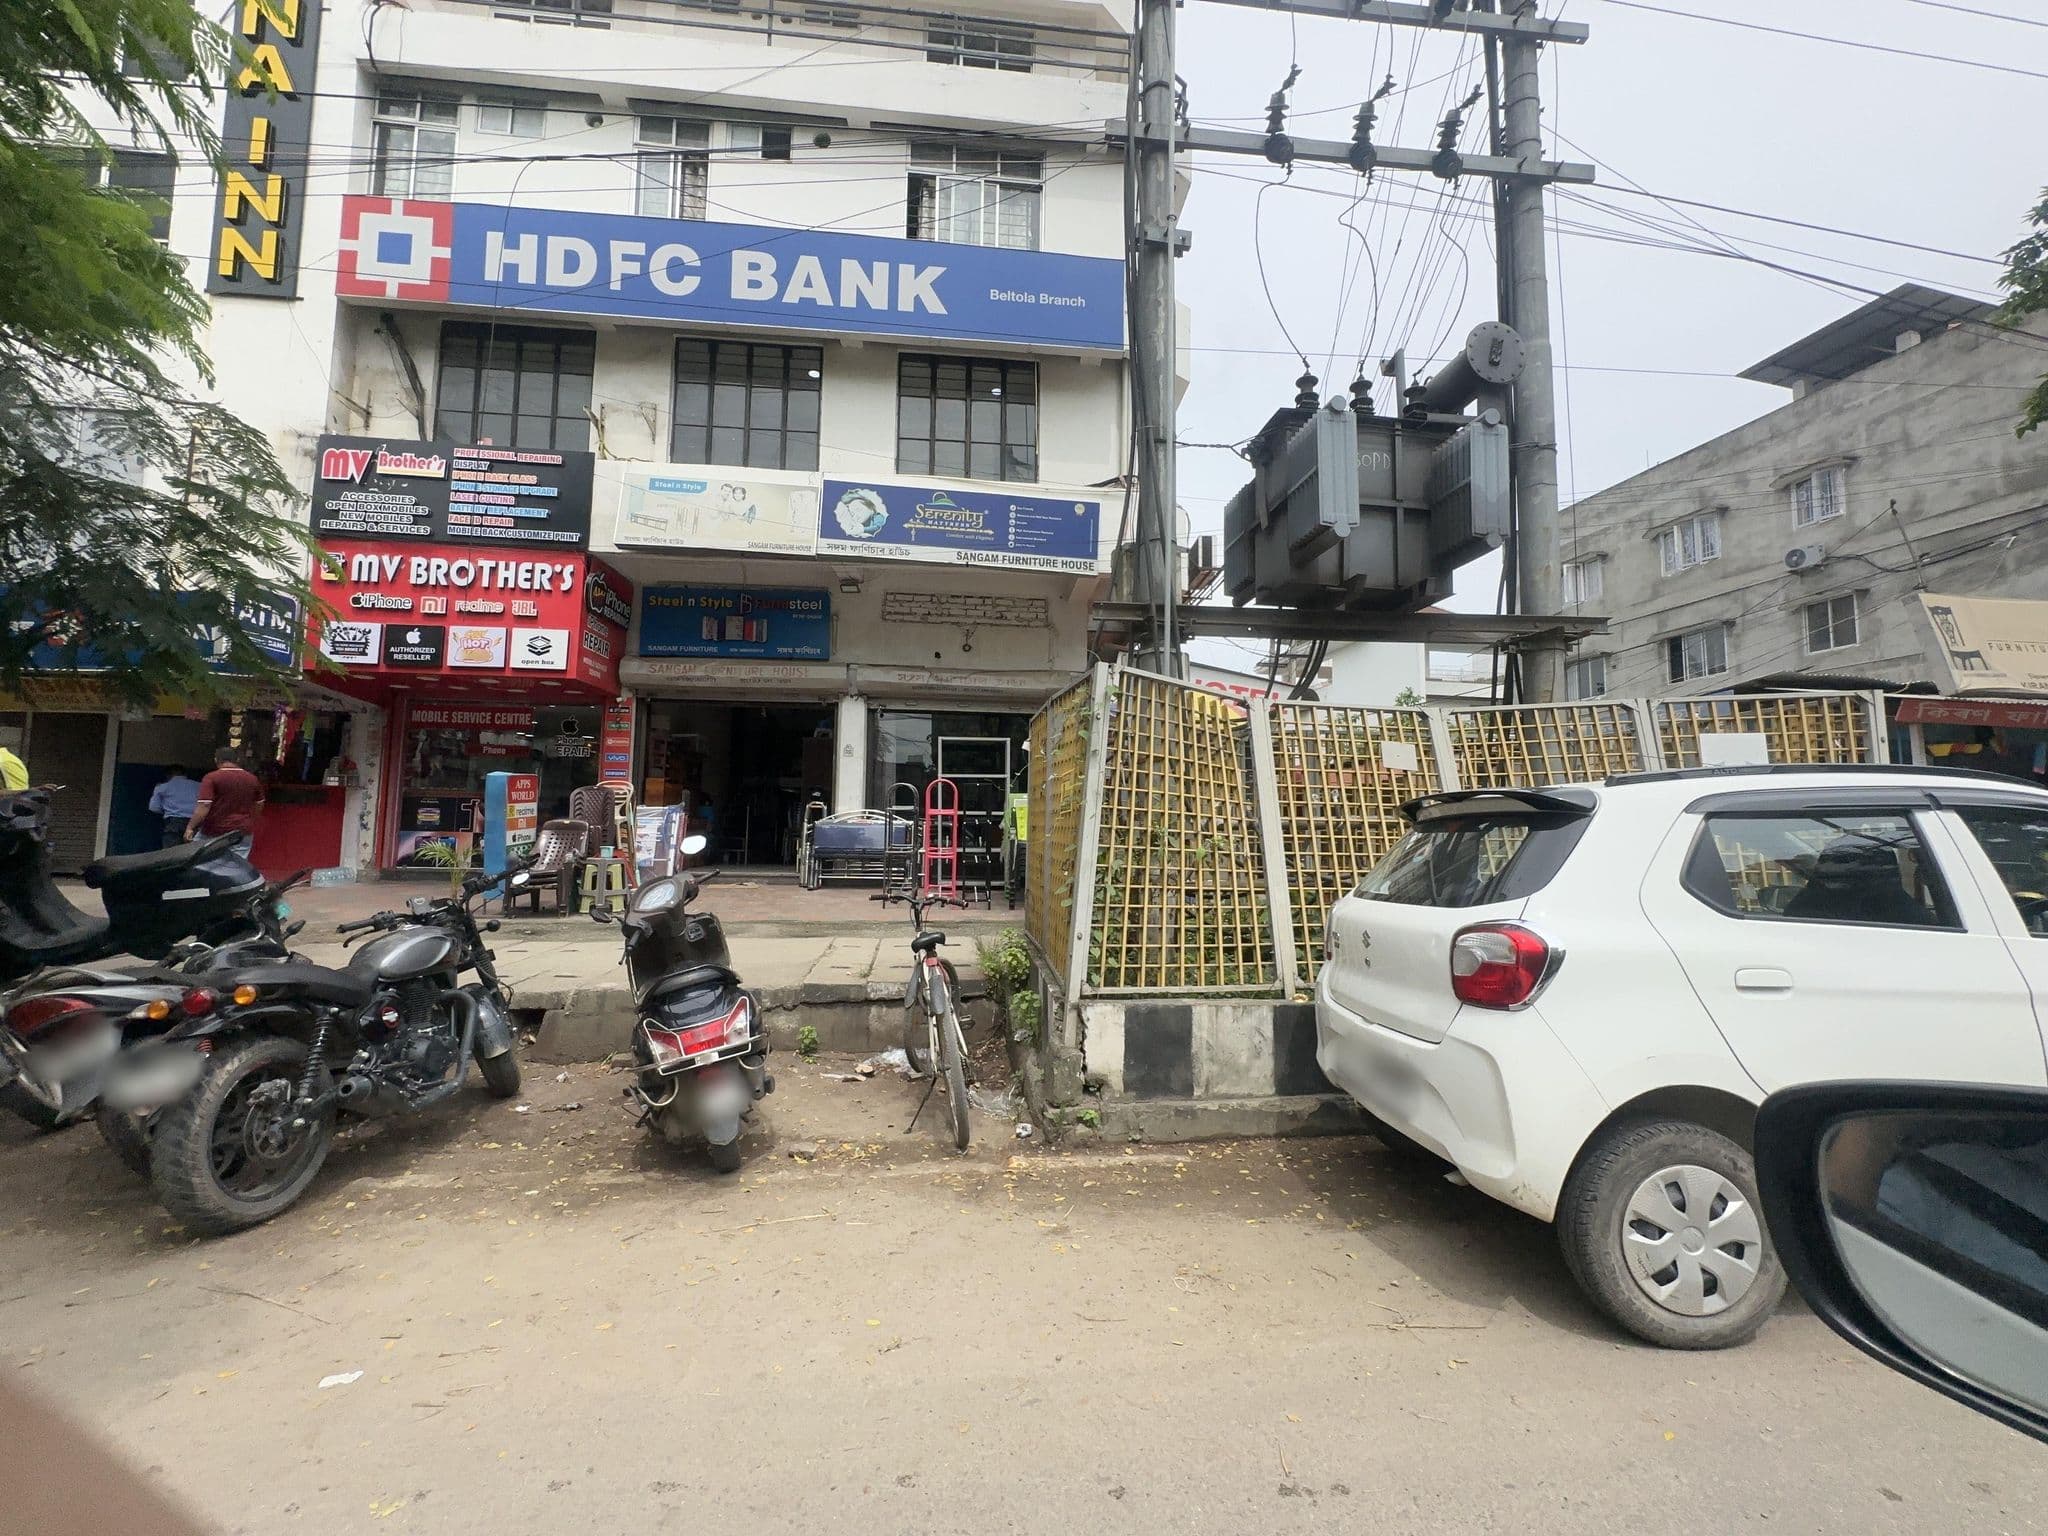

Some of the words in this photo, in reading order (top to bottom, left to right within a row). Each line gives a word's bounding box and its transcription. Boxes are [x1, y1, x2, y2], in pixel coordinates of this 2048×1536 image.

[484, 231, 702, 297] HDFC
[731, 249, 949, 315] BANK
[990, 289, 1035, 303] Beltola
[1039, 293, 1086, 307] Branch
[377, 451, 446, 472] Brother's
[453, 460, 490, 470] DISPLAY
[517, 453, 562, 464] REPAIRING
[485, 472, 509, 482] BACK
[509, 474, 538, 484] GLASS
[451, 481, 482, 491] IPHONE
[483, 483, 519, 494] STORAGE
[520, 486, 558, 496] UPGRADE
[681, 483, 701, 491] Style
[341, 491, 416, 504] ACCESSORIES
[450, 492, 478, 502] LASER
[479, 494, 515, 505] CUTTING
[325, 501, 356, 511] OPEN
[358, 502, 381, 513] BOX
[381, 504, 430, 516] MOBILES
[486, 507, 549, 518] REPLACEMENT
[339, 510, 365, 521] NEW
[366, 513, 413, 524] MOBILES
[448, 514, 471, 524] FACE
[482, 516, 514, 527] REPAIR
[914, 503, 984, 529] Serenity
[320, 520, 366, 531] REPAIRS
[367, 523, 377, 533] &
[378, 524, 430, 535] SERVICES
[928, 520, 970, 528] MATTRESS
[447, 525, 480, 536] MOBILE
[481, 527, 506, 538] BACK
[506, 529, 553, 540] CUSTOMIZE
[554, 532, 580, 542] PRINT
[747, 541, 769, 549] SANGAM
[769, 543, 795, 551] FURNITURE
[956, 551, 999, 565] SANGAM
[1002, 554, 1057, 569] FURNITURE
[1061, 558, 1095, 572] HOUSE
[409, 556, 575, 591] BROTHER'S
[364, 593, 411, 610] iPhone
[455, 599, 504, 613] realme
[511, 600, 537, 616] JBL
[649, 595, 684, 607] Steel
[688, 598, 695, 607] n
[700, 596, 733, 610] Style
[239, 599, 293, 634] ATM
[389, 646, 436, 654] AUTHORIZED
[463, 639, 489, 649] HOT
[583, 630, 610, 659] REPAIR
[679, 646, 718, 654] FURNITURE
[393, 653, 431, 661] RESELLER
[649, 664, 697, 675] SANGAM
[411, 709, 449, 724] MOBILE
[451, 711, 492, 725] SERVICE
[494, 712, 532, 726] CENTRE
[554, 746, 592, 758] EPAIR
[516, 779, 531, 789] APPS
[511, 791, 535, 801] WORLD
[516, 806, 535, 817] realme
